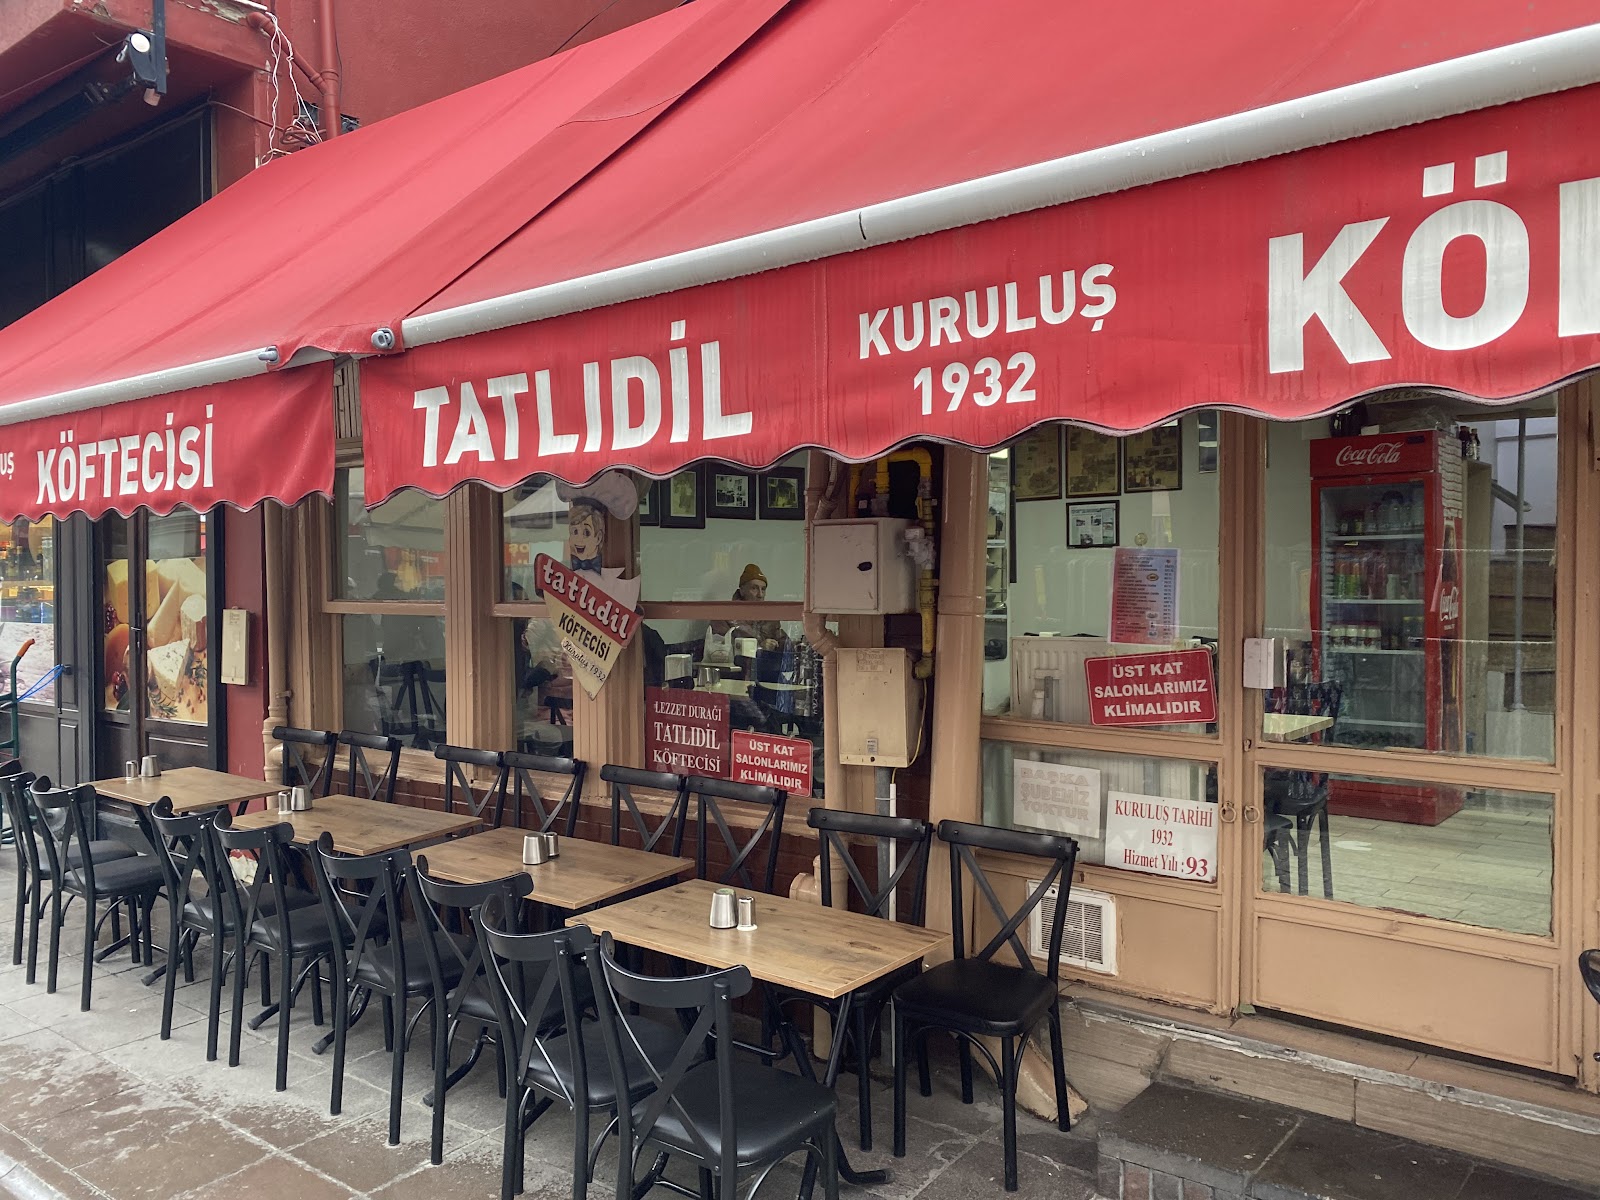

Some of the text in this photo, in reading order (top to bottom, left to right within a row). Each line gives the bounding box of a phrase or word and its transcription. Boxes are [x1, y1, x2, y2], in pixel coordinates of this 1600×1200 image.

[859, 263, 1117, 360] KURULUŞ
[414, 320, 752, 467] TATLIDİL
[914, 351, 1036, 416] 1932
[36, 404, 214, 504] KÖFTECİSİ
[1335, 441, 1405, 467] Coca-Cola
[558, 612, 611, 662] KÖFTECİSİ
[589, 664, 606, 682] 1932
[1112, 662, 1183, 678] ÜST KAT
[1094, 679, 1208, 699] SALONLARIMIZ
[654, 701, 722, 722] LEZZET DURAĞI
[1104, 700, 1202, 717] KLİMALIDIR
[653, 721, 721, 750] TATLIDİL
[749, 738, 795, 757] ÜST KAT
[652, 748, 721, 773] KÖFTECİSİ
[735, 753, 808, 775] SALONLARIMIZ
[740, 769, 802, 789] KLİMALIDIR
[1020, 767, 1090, 786] BAŞKA
[1020, 782, 1090, 807] ŞUBEMİZ
[1022, 801, 1090, 821] YOKTUR
[1115, 799, 1213, 828] KURULUŞ TARİHİ
[1151, 828, 1173, 846] 1932
[1123, 848, 1158, 868] Hizmet
[1160, 853, 1178, 872] Yılı
